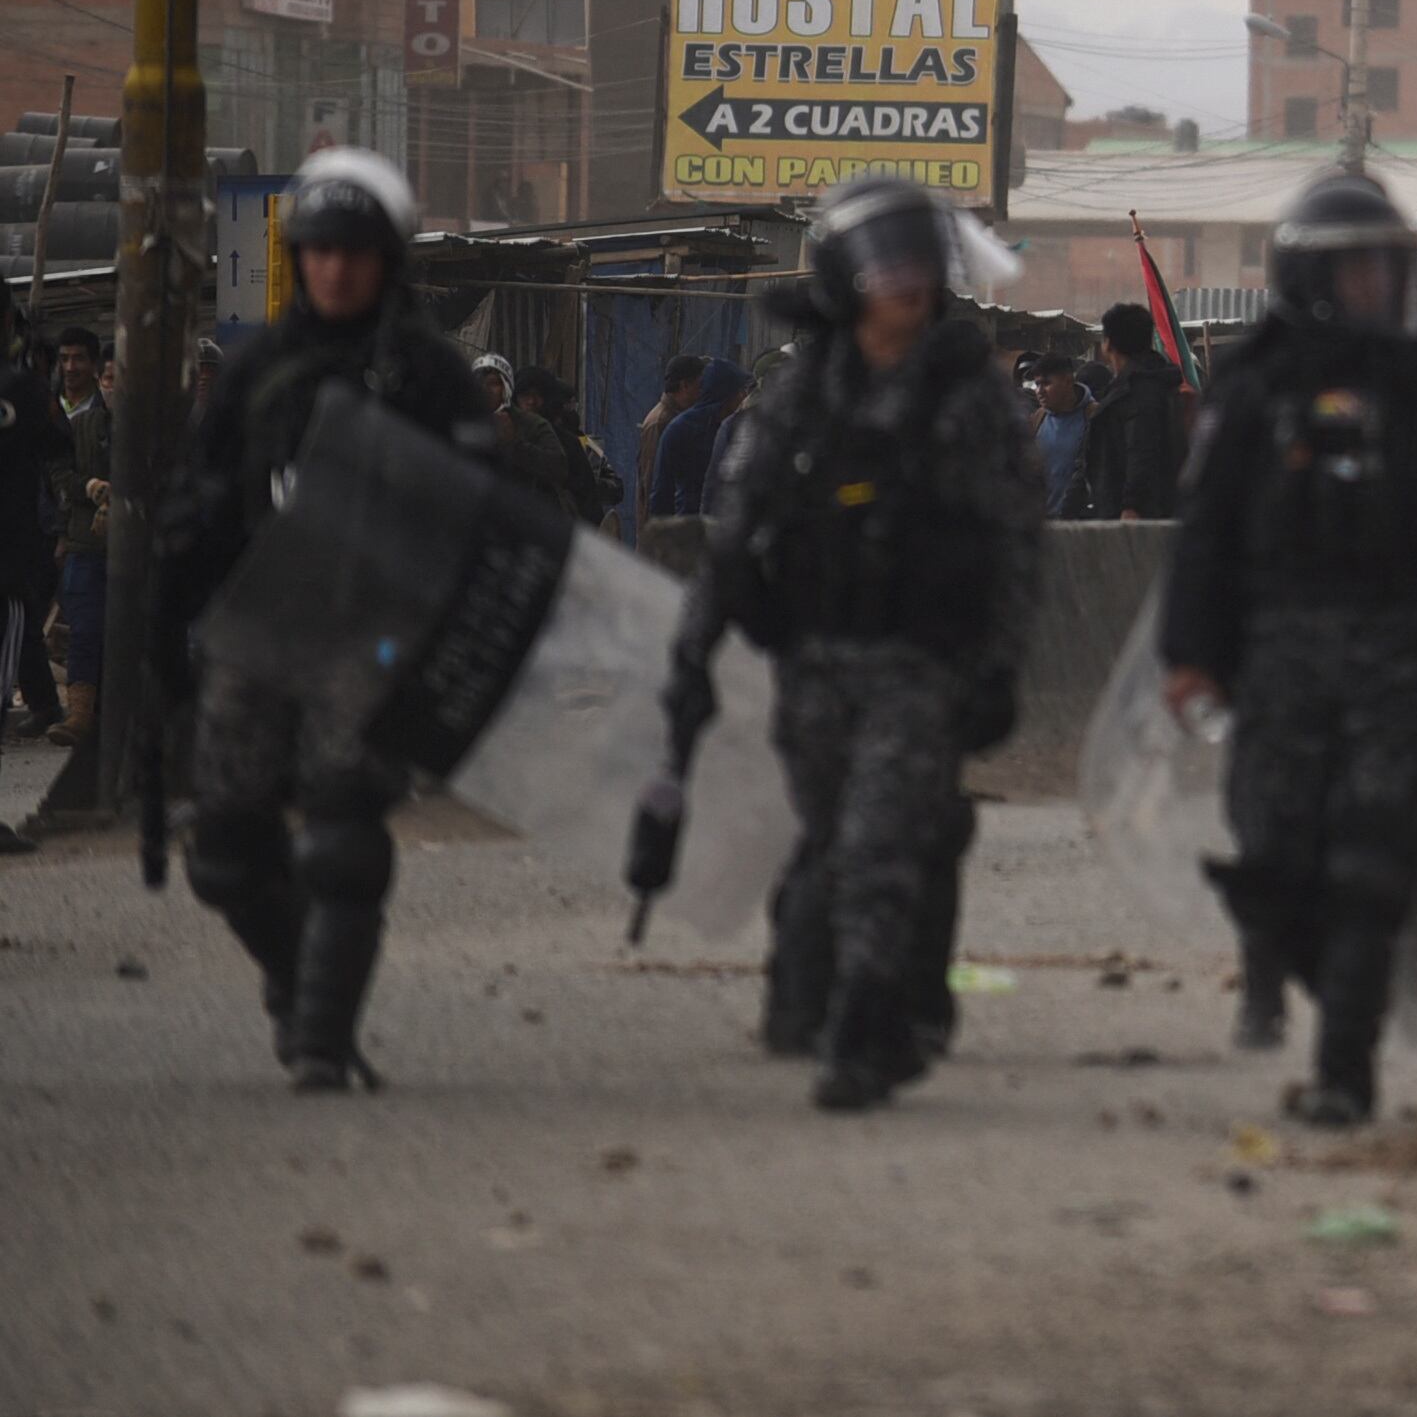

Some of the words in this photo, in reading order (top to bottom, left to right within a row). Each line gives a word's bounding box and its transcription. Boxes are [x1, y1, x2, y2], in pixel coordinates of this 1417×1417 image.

[682, 41, 978, 85] ESTRELLAS
[705, 103, 739, 133] A
[749, 103, 773, 133] 2
[784, 105, 981, 139] CUADRAS
[674, 154, 764, 186] CON
[777, 157, 981, 190] PARQUEO
